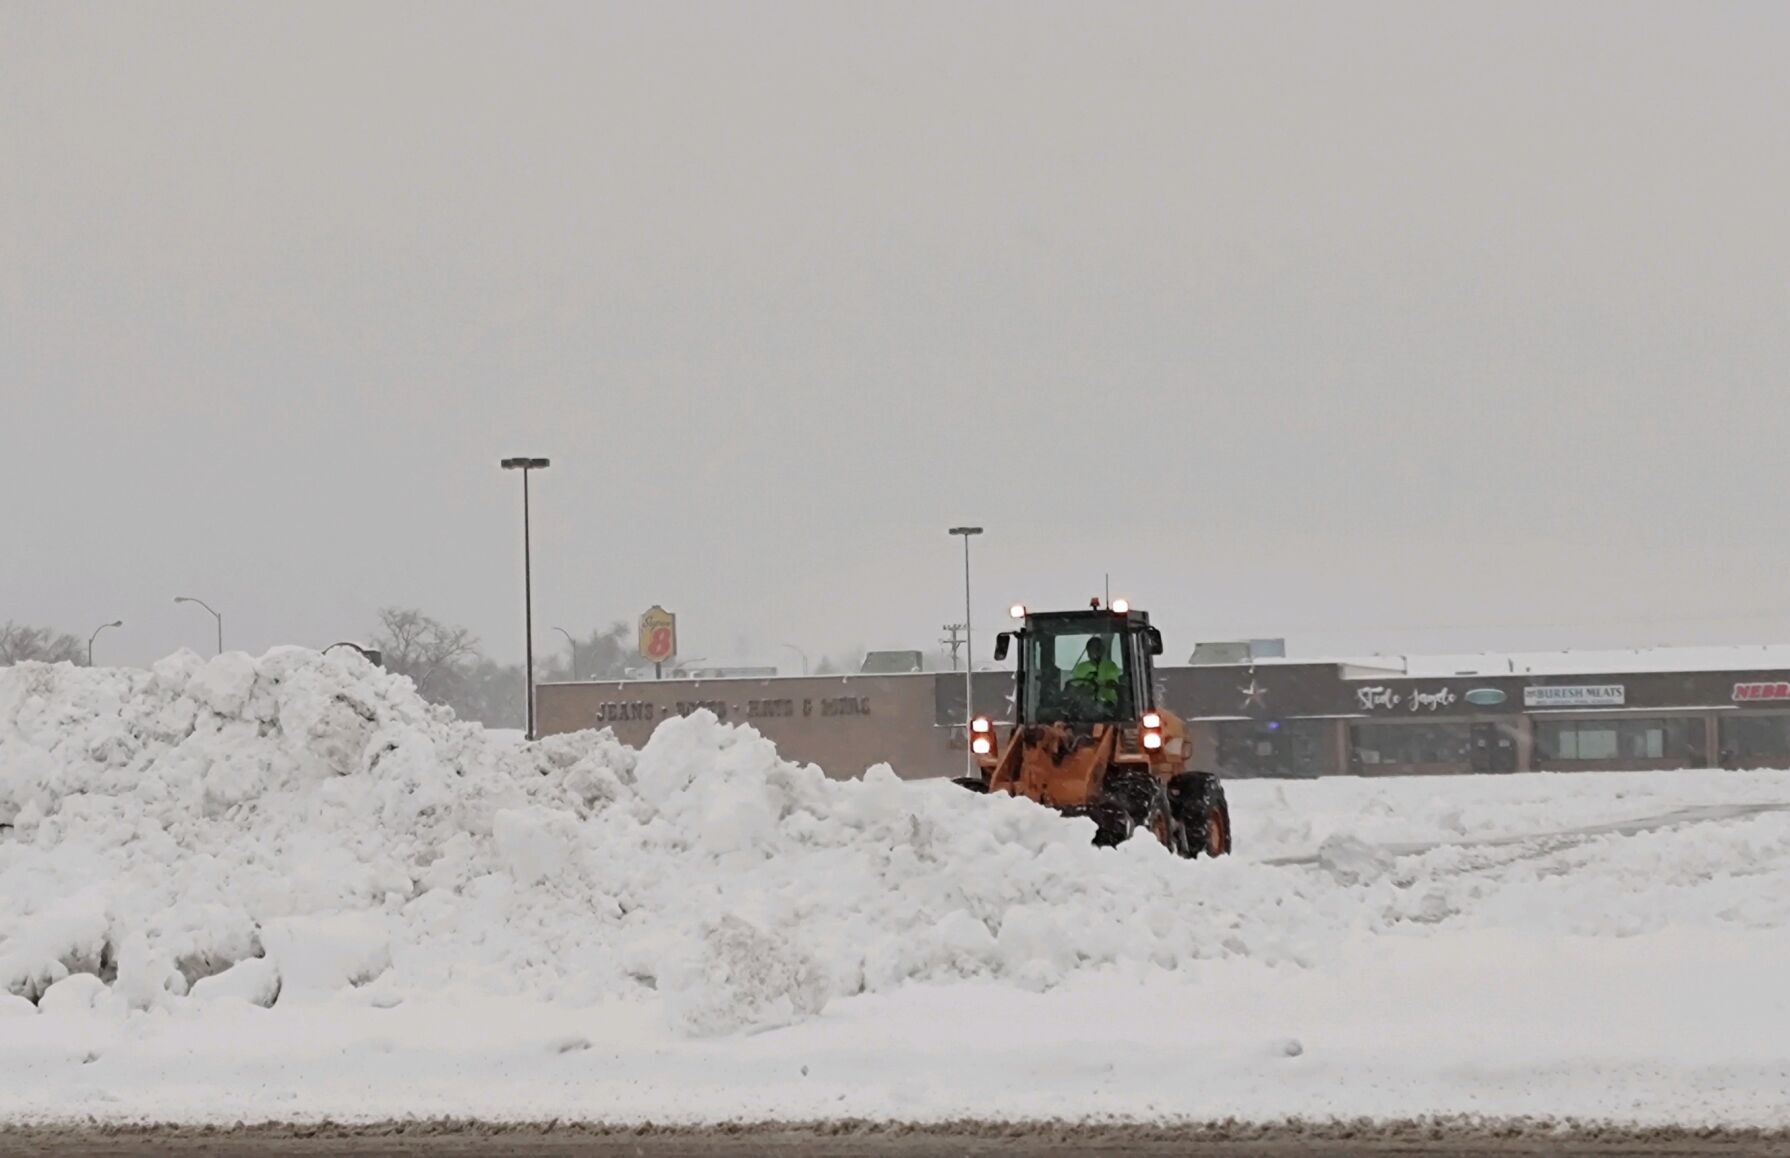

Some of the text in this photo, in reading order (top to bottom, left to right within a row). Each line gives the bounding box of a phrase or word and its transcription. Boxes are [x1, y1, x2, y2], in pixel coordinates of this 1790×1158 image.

[648, 627, 672, 657] 8
[1536, 687, 1622, 699] BURESH MEATS
[596, 700, 654, 722] JEANS
